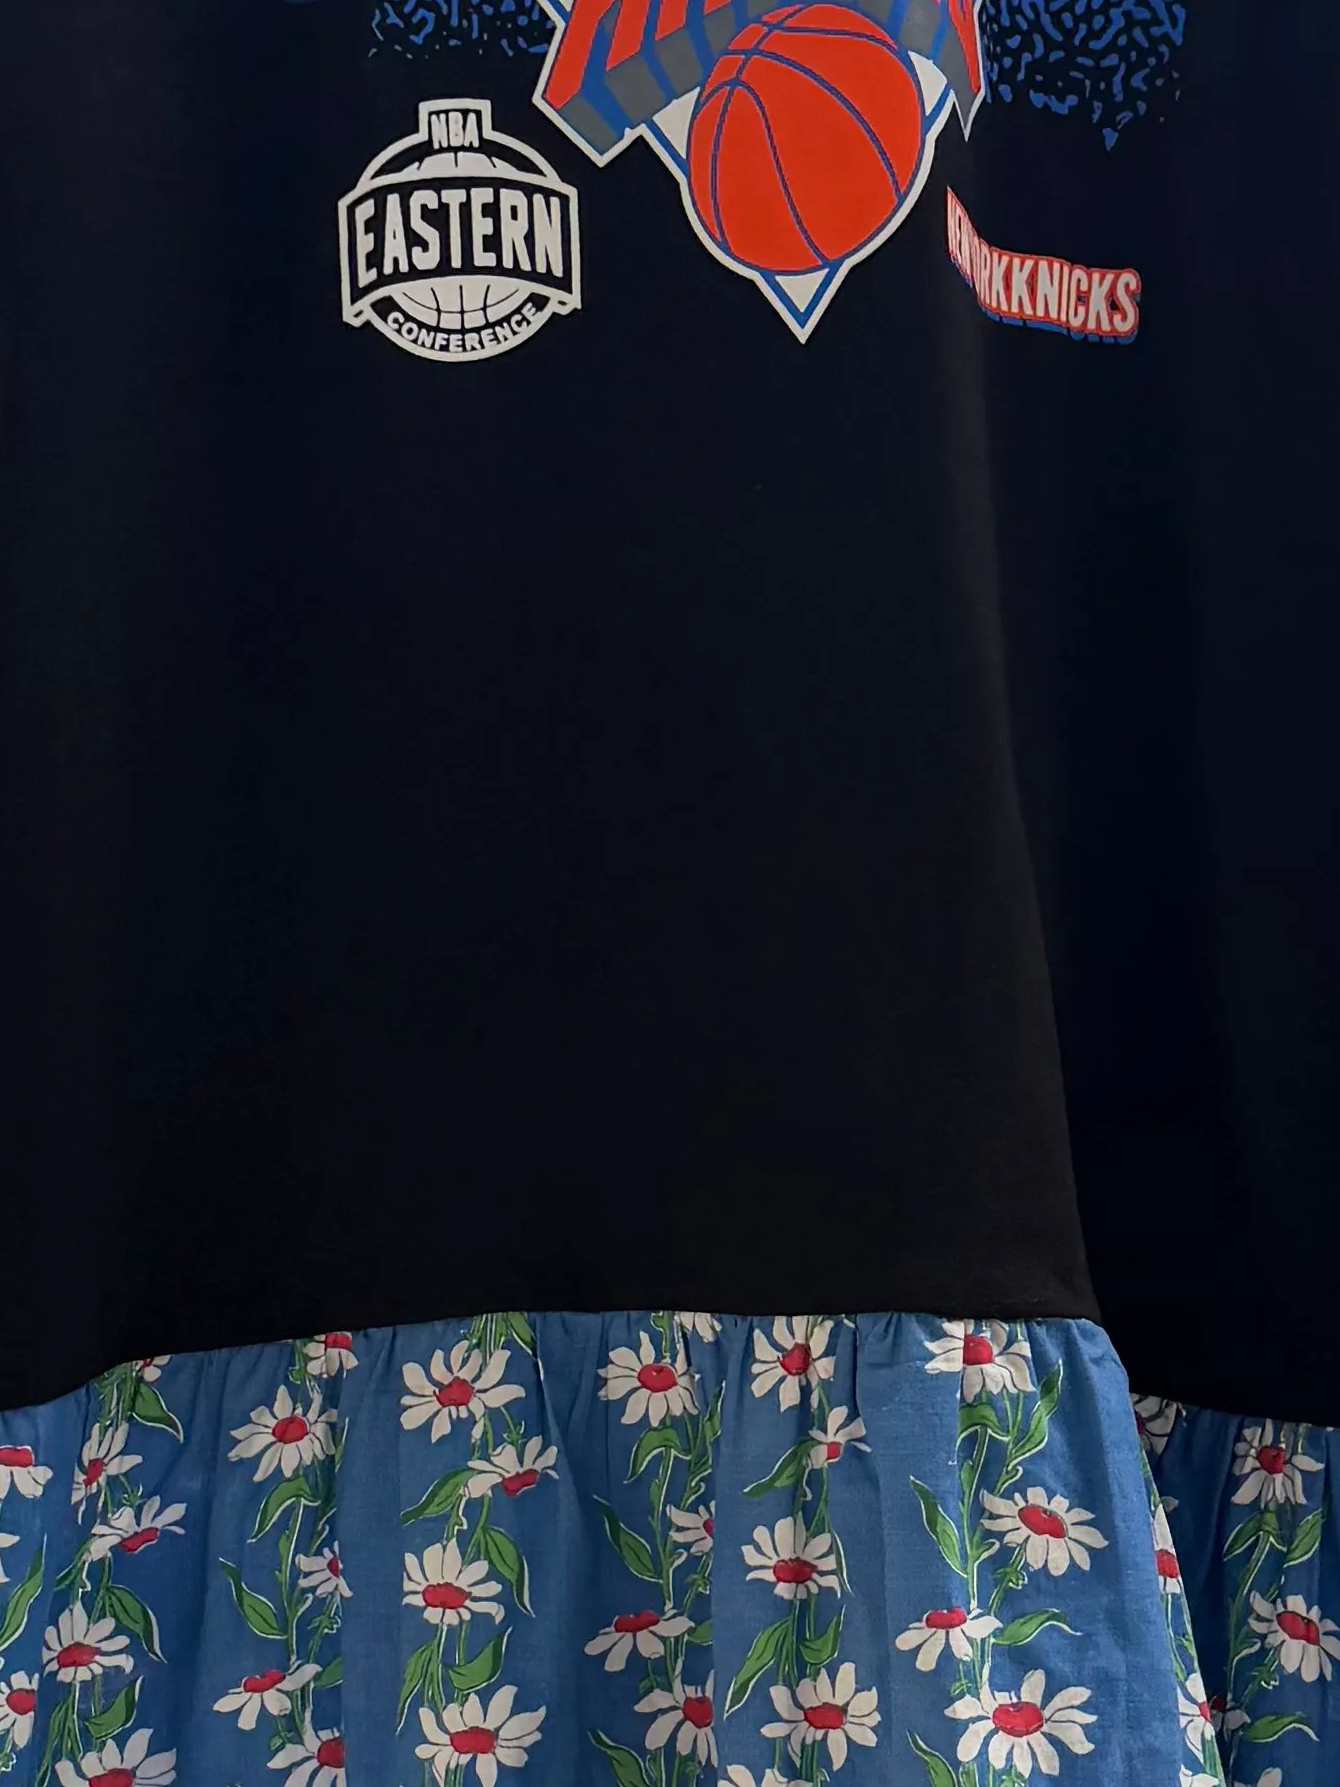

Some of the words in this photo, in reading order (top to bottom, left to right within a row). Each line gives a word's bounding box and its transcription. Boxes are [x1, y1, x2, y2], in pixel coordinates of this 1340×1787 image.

[430, 110, 480, 150] NBA
[354, 186, 565, 289] EASTERN
[386, 301, 540, 353] CONFERENCE
